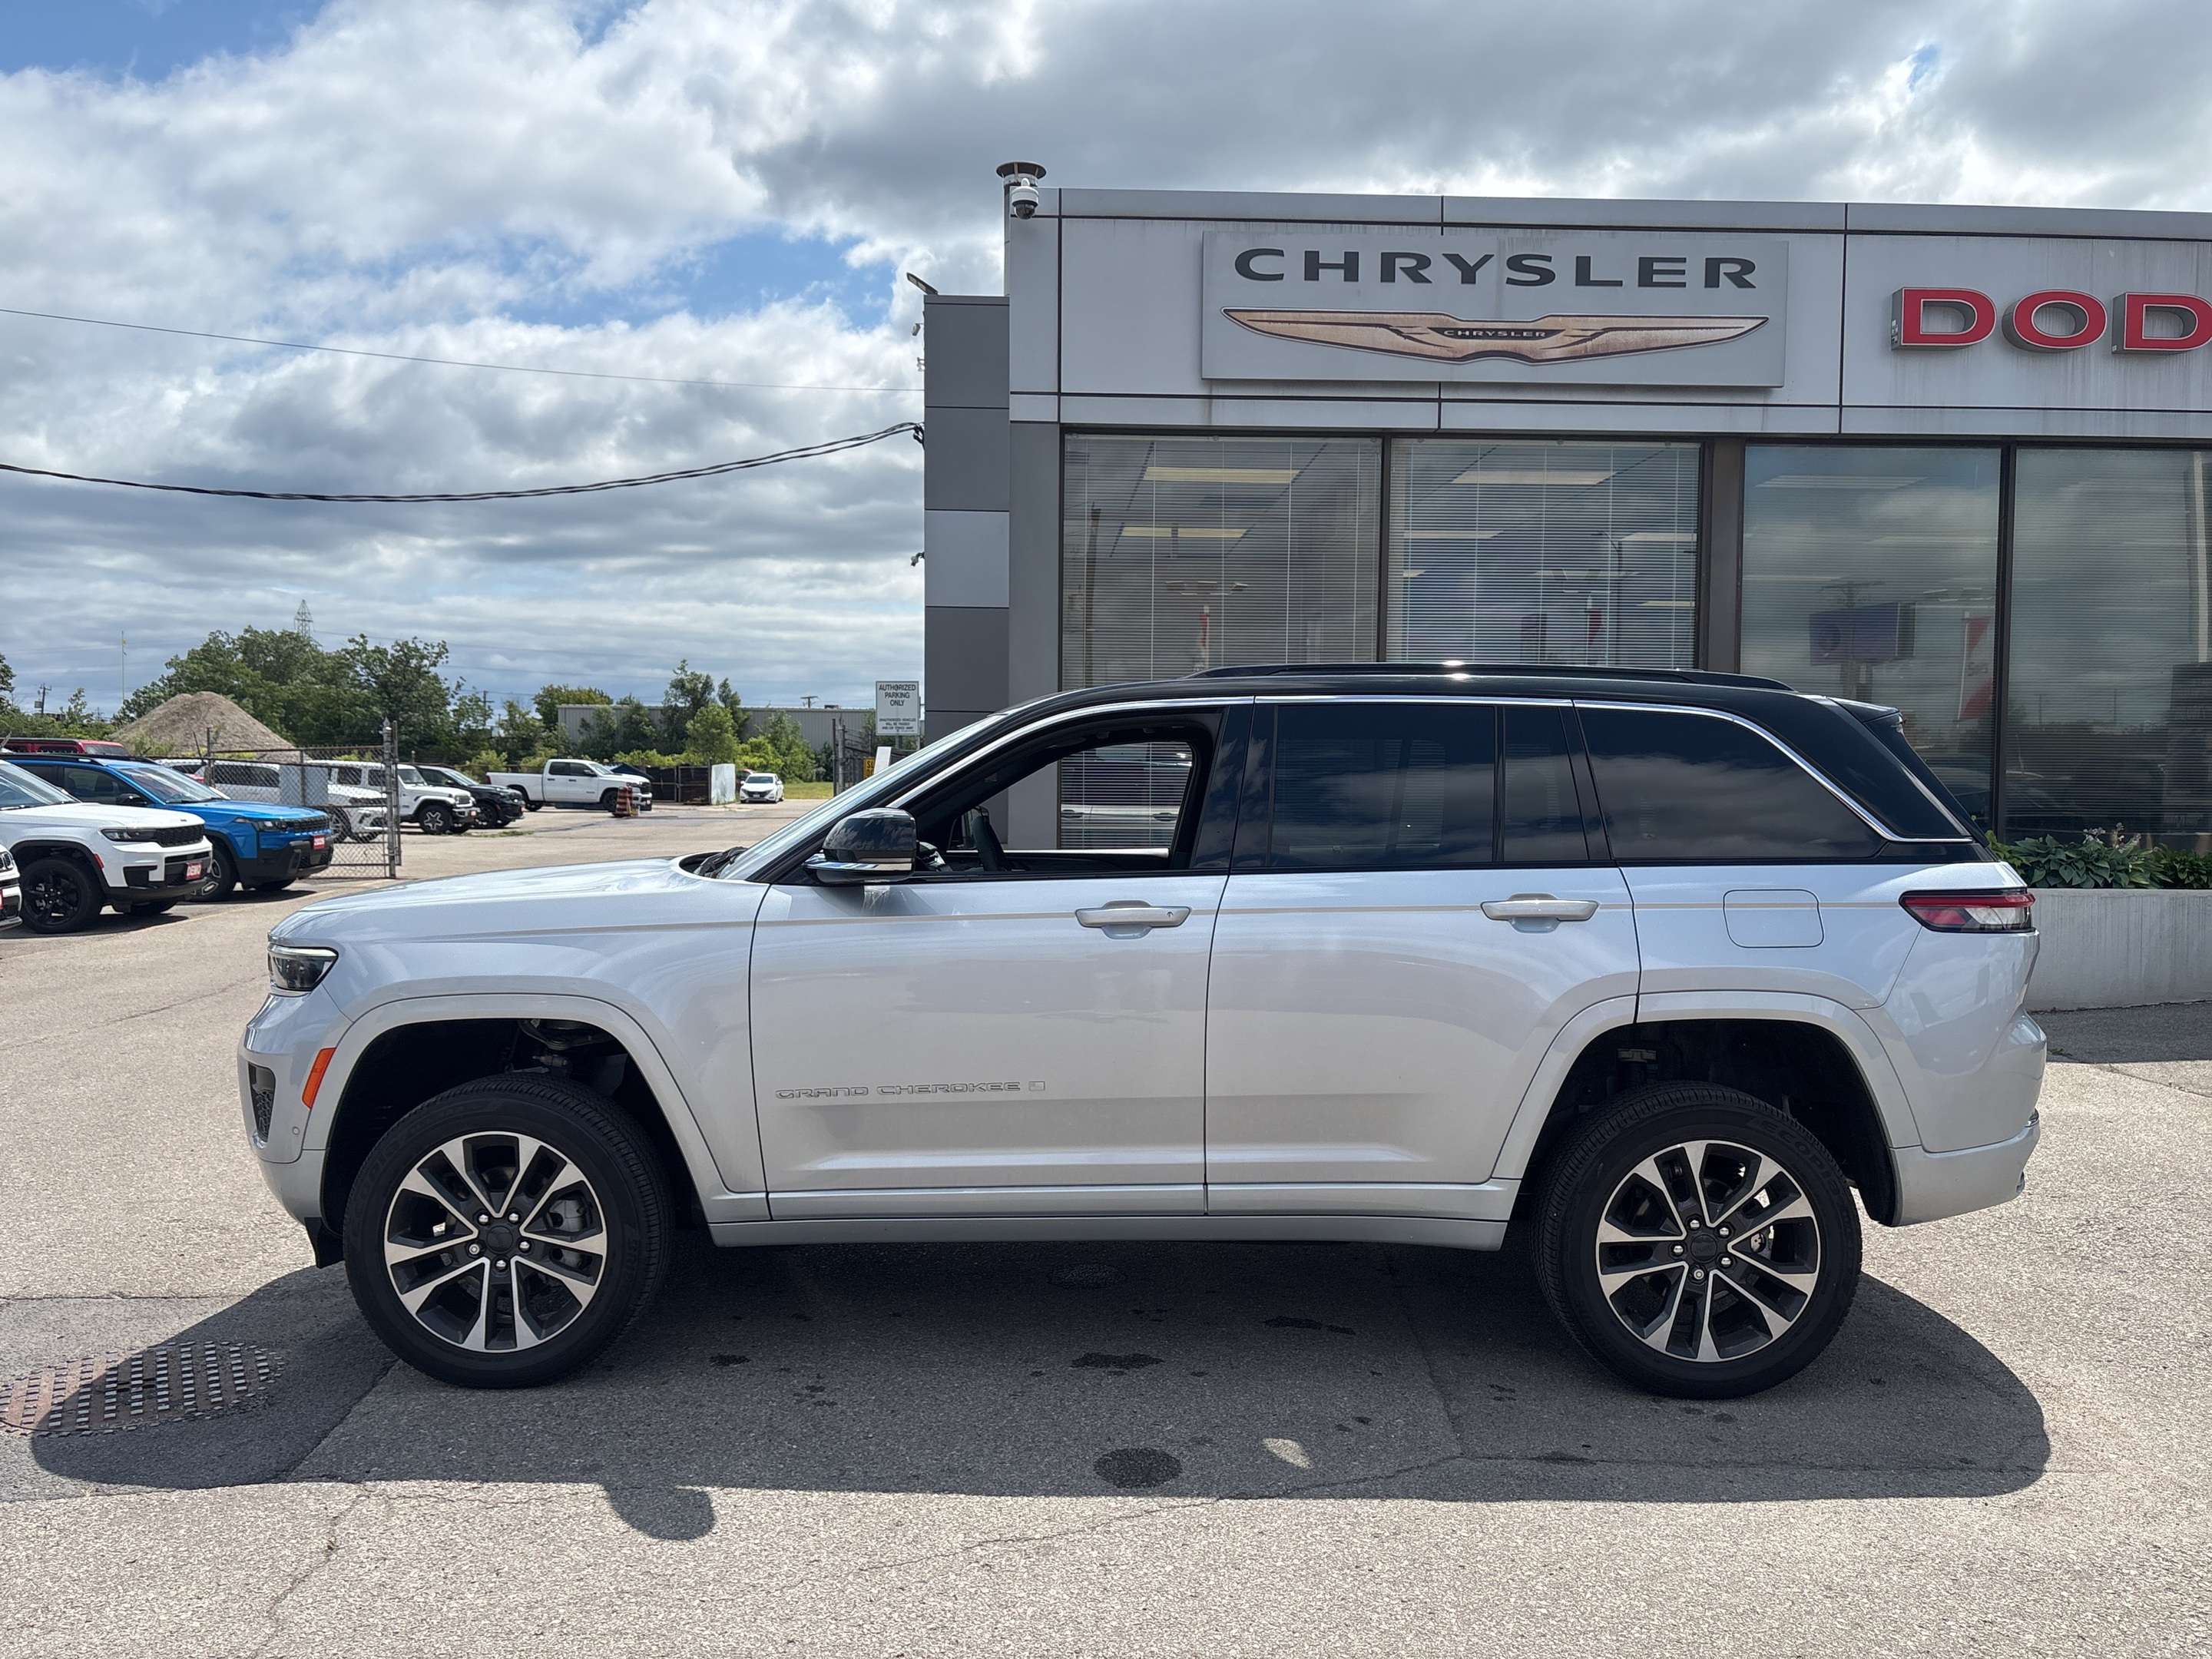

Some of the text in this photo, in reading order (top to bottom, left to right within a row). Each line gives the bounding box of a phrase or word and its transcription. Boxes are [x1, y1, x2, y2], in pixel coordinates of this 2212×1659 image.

[1234, 247, 1757, 289] CHRYSLER
[775, 1081, 1021, 1099] GRAND CHEROKEE
